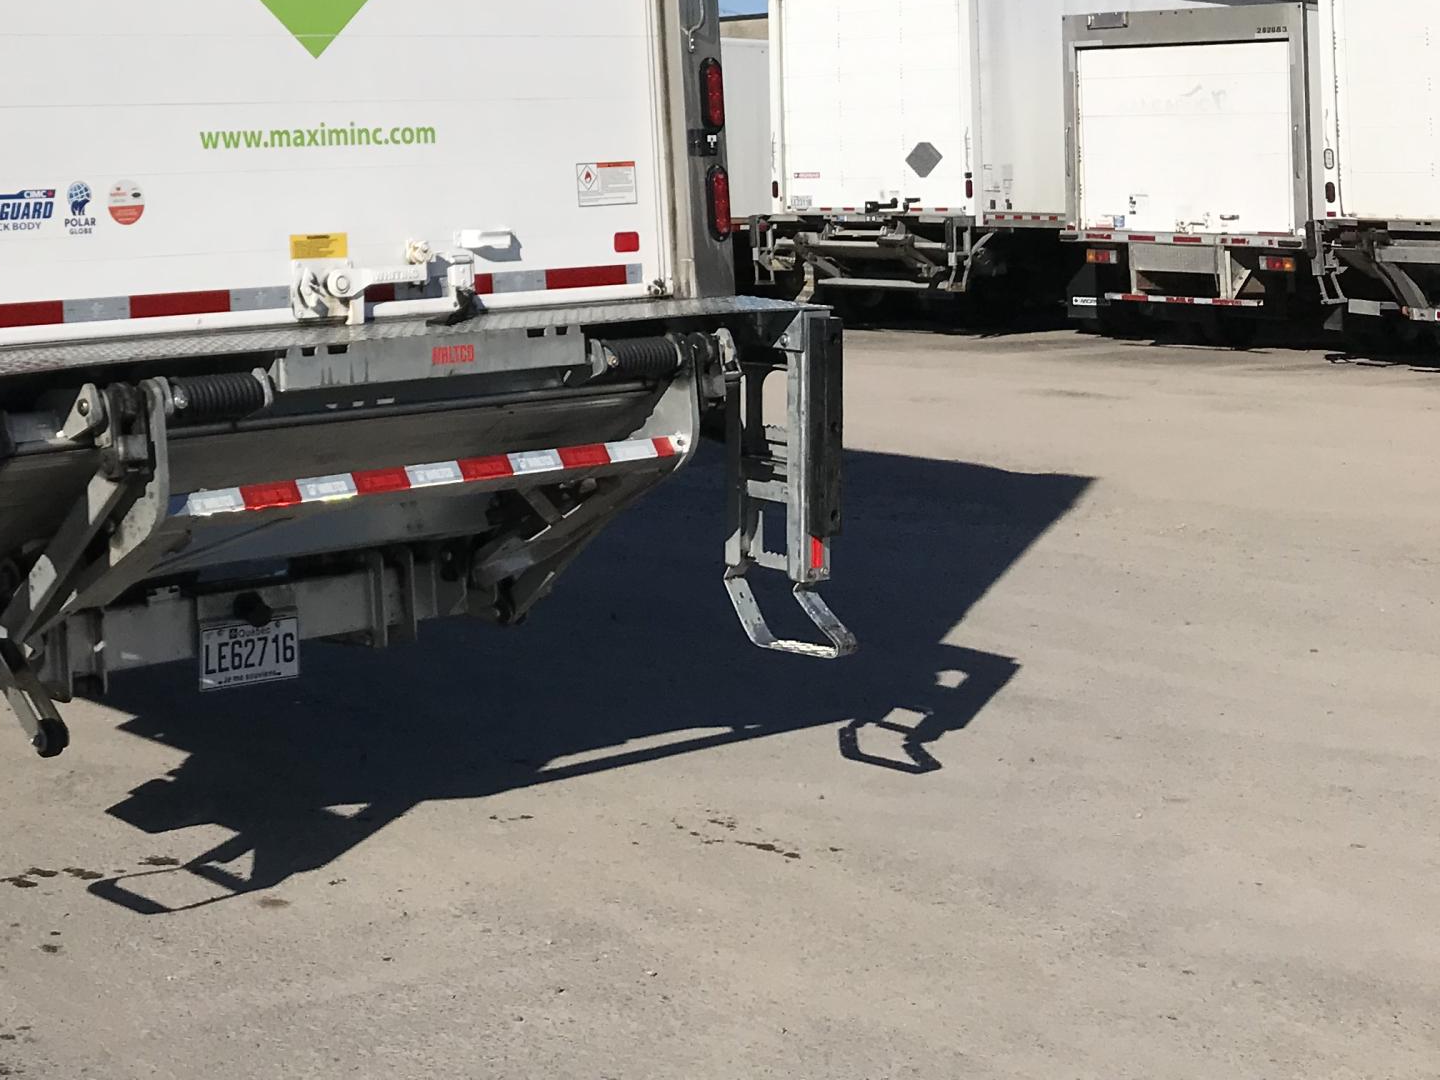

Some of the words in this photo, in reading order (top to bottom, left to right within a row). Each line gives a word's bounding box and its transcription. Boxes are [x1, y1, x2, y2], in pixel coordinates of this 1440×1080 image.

[199, 121, 436, 150] www.maximinc.com
[12, 221, 42, 231] BODY
[64, 217, 96, 228] POLAR
[69, 227, 93, 235] GLOBE
[205, 632, 295, 675] LE62716
